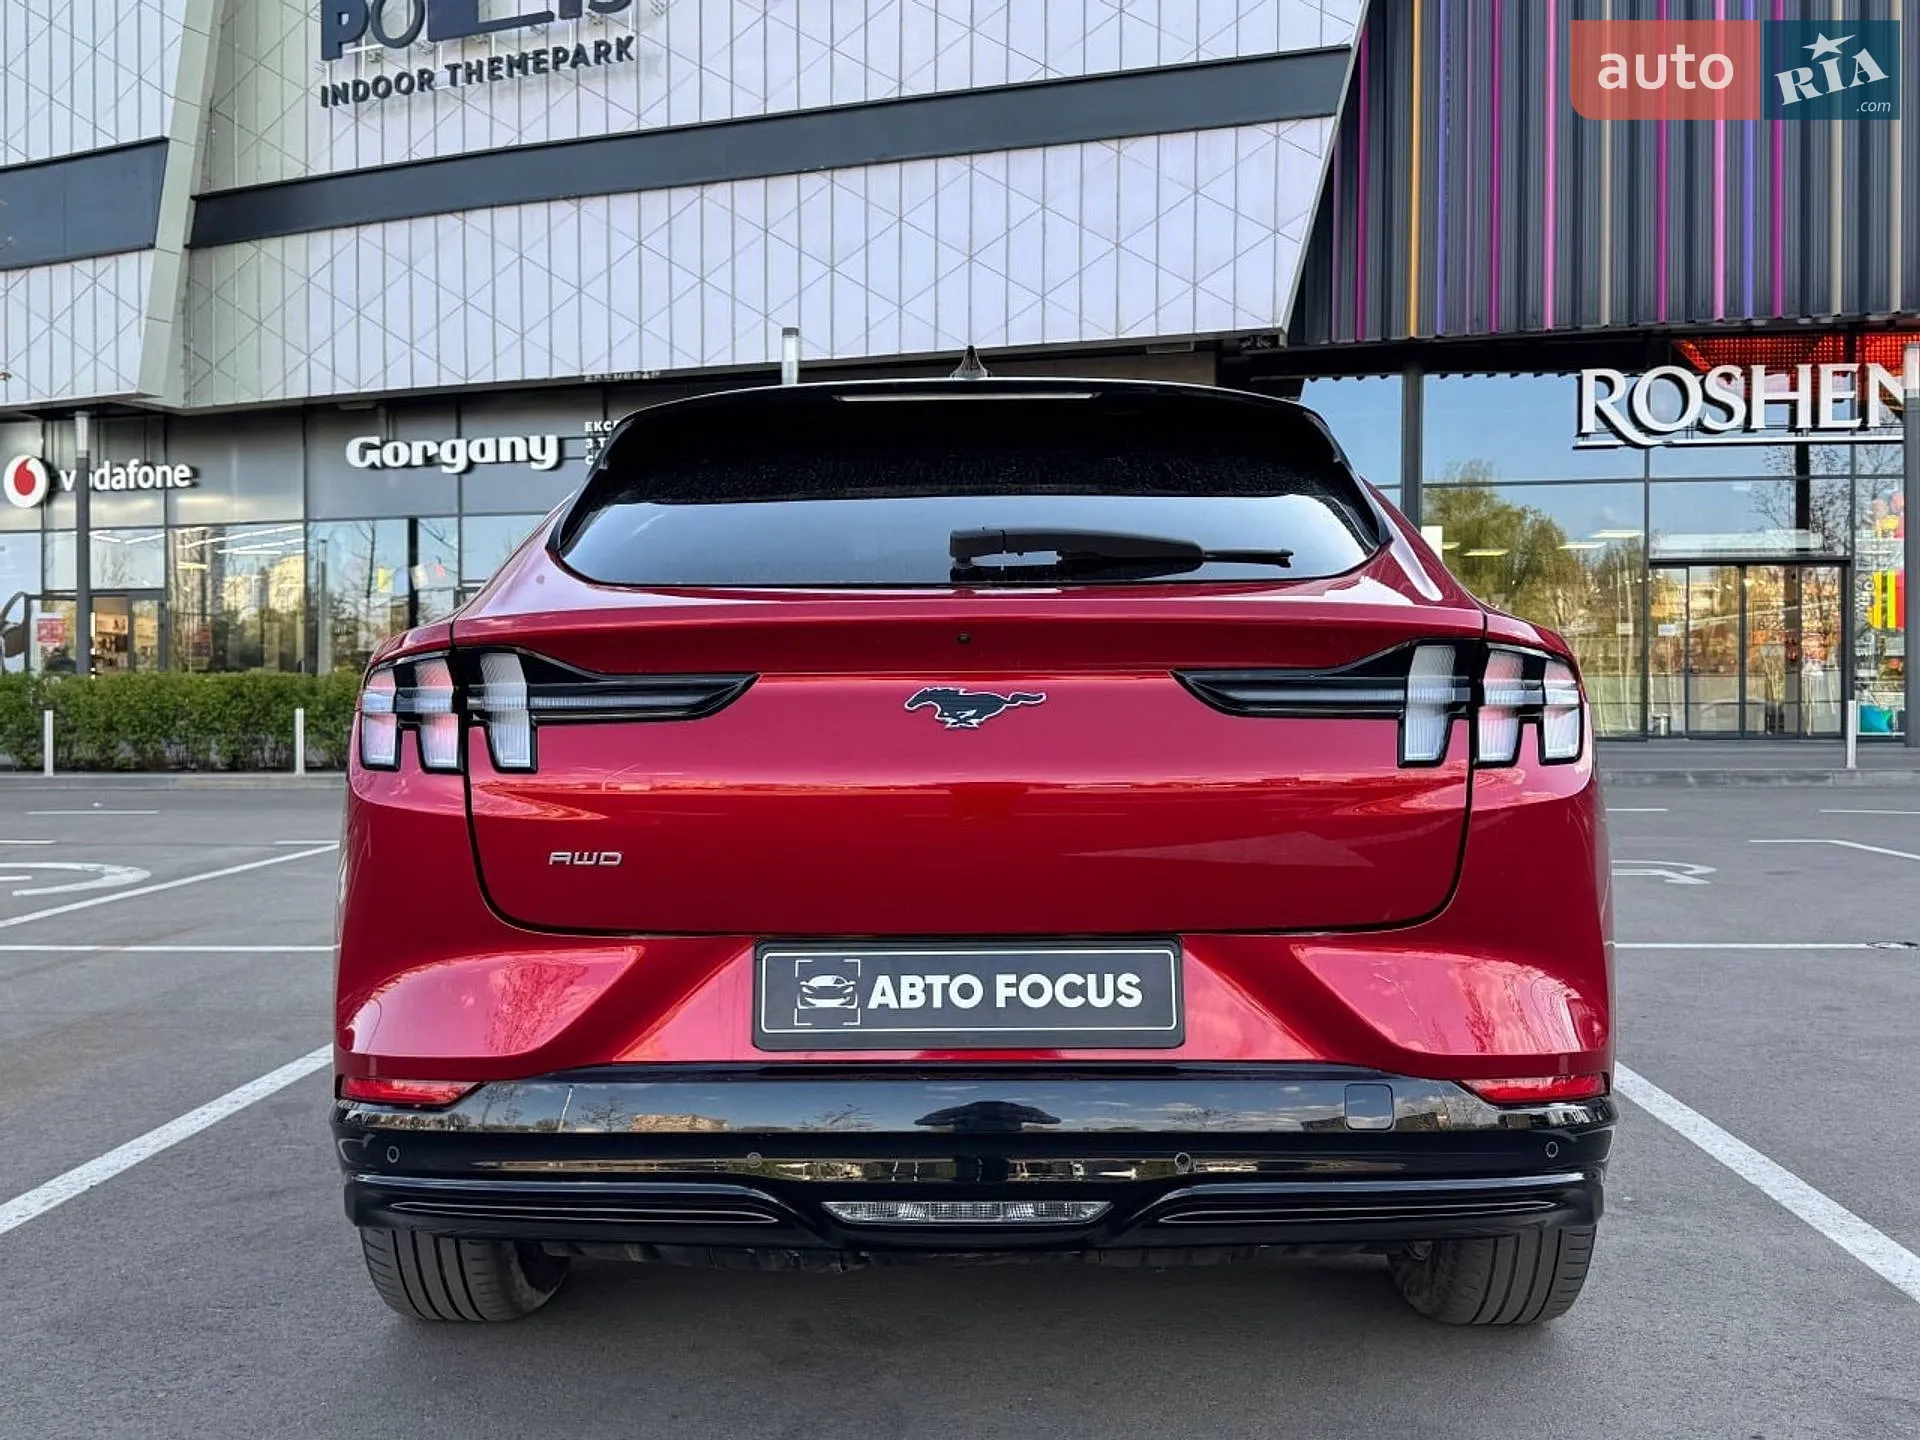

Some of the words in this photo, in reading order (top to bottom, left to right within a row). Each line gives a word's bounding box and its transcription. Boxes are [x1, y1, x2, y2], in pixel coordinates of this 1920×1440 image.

[320, 67, 437, 108] INDOOR
[444, 35, 635, 88] THEMEPARK
[345, 434, 559, 474] Gorgany
[59, 458, 193, 492] vdafone
[548, 851, 622, 866] AWD
[995, 973, 1143, 1009] FOCUS
